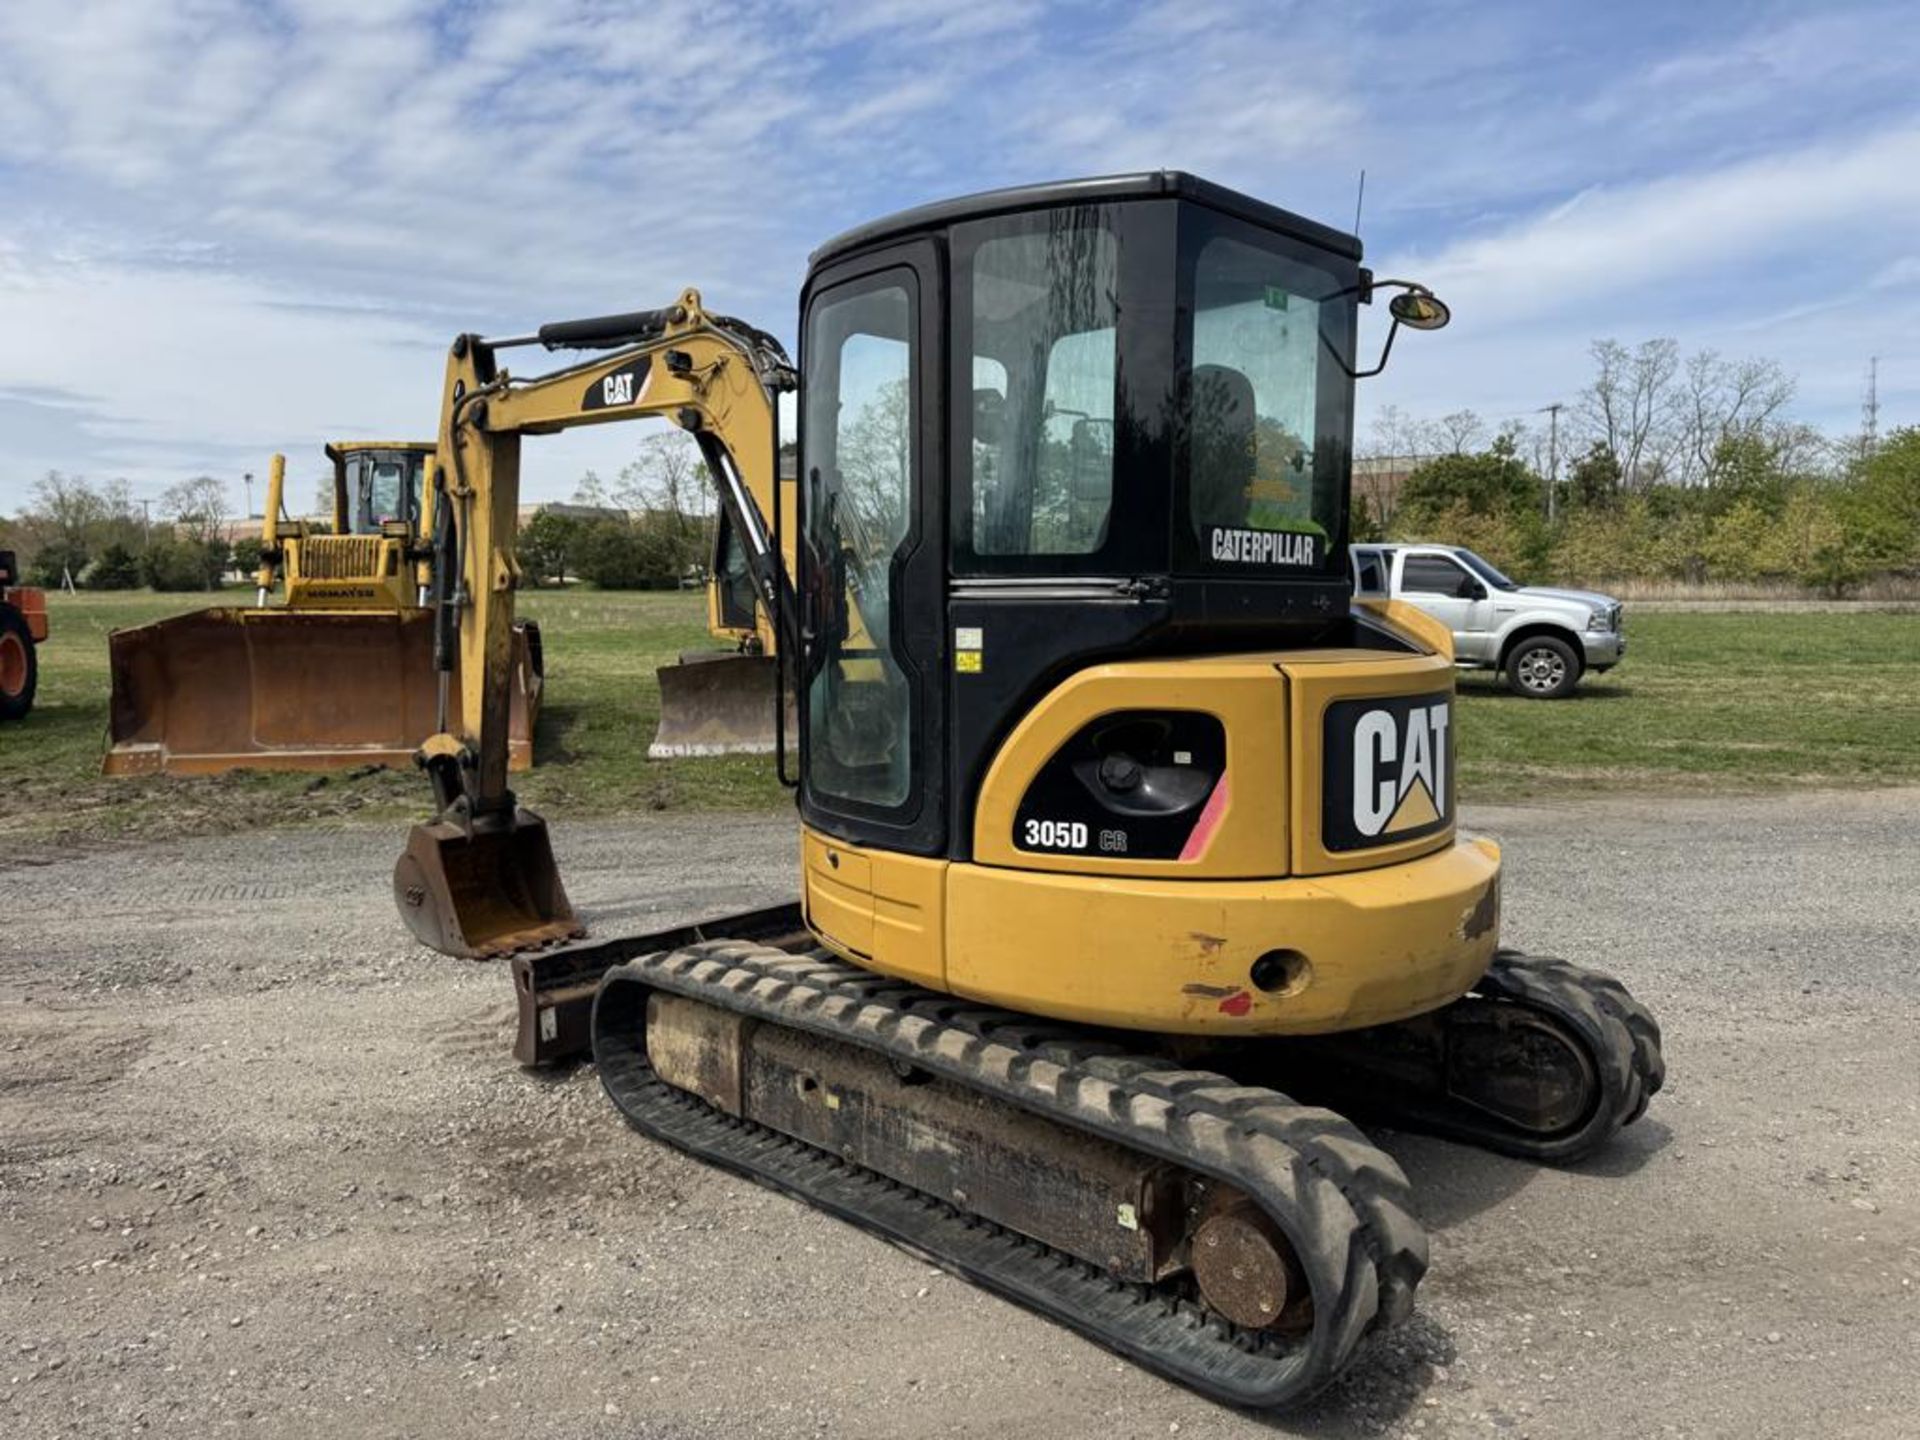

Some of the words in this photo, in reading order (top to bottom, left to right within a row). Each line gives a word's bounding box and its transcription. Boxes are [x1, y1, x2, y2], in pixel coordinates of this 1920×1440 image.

[603, 372, 634, 406] CAT
[1211, 527, 1314, 566] CATERPILLAR
[1353, 702, 1449, 837] CAT
[1024, 818, 1089, 849] 305D
[1099, 829, 1128, 852] CR
